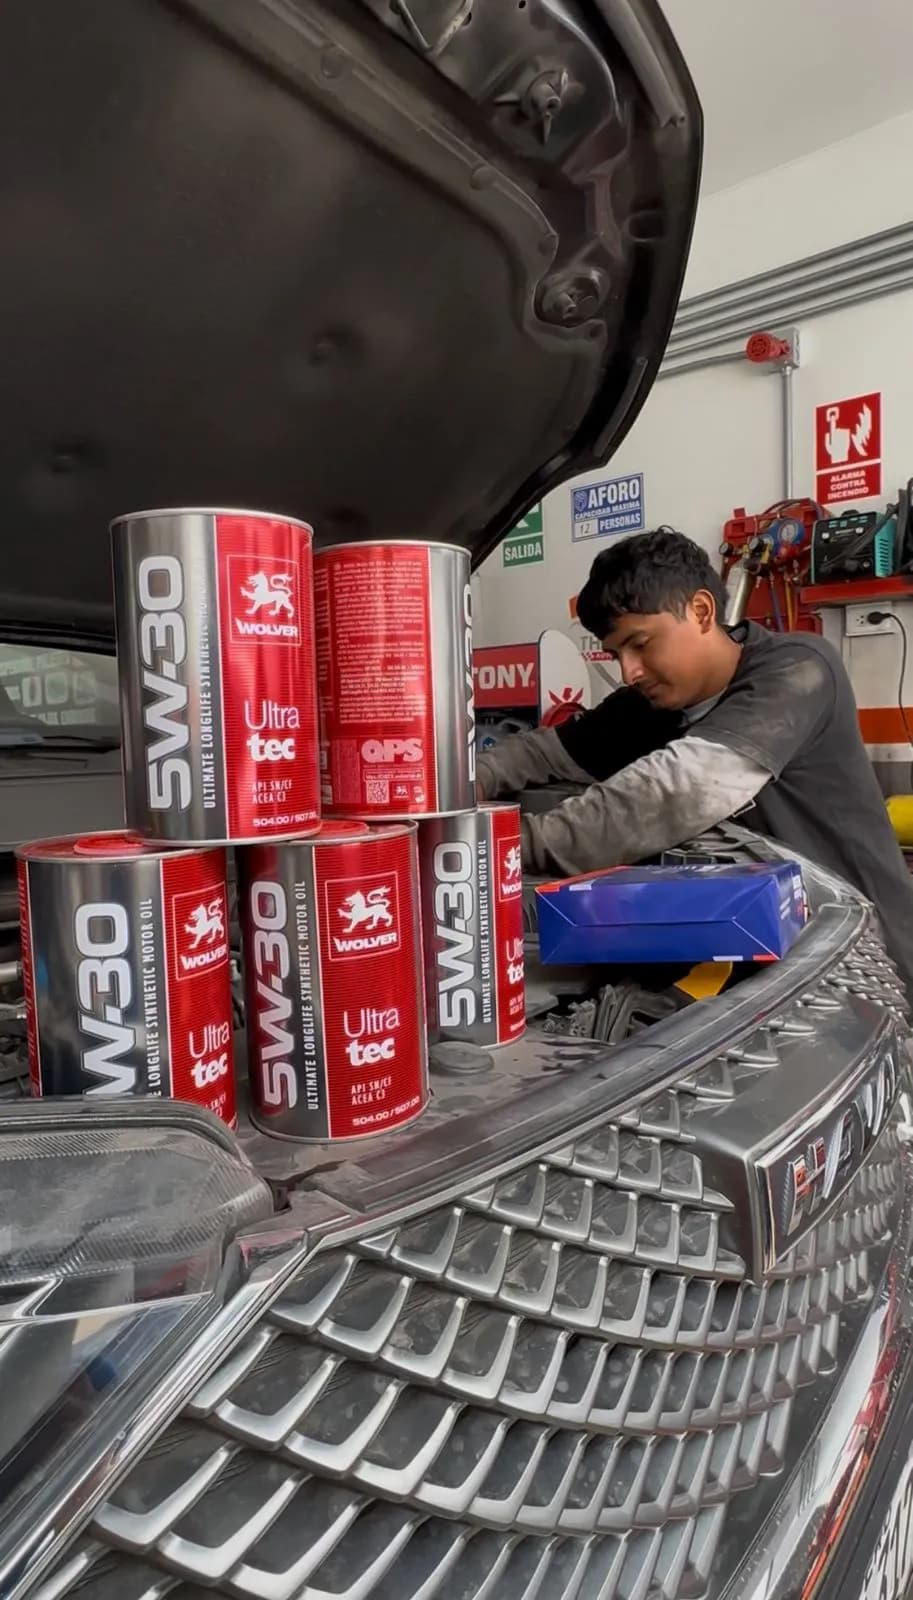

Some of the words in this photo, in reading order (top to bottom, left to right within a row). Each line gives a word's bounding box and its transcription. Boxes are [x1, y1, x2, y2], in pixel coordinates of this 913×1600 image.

[830, 470, 866, 482] ALARMA
[830, 479, 866, 491] CONTRA
[588, 479, 640, 509] AFORO
[827, 487, 869, 500] INCENDIO
[575, 507, 611, 520] CAPACIDAD
[600, 513, 641, 531] PERSONAS
[504, 542, 542, 561] SALIDA
[235, 617, 298, 637] WOLVER
[581, 635, 602, 650] TH
[200, 691, 213, 748] LONGLIFE
[244, 700, 300, 730] Ultra
[246, 732, 296, 762] tec
[203, 753, 216, 809] ULTIMATE
[252, 781, 267, 792] API
[252, 792, 274, 804] ACEA
[252, 815, 290, 827] 504.00
[477, 840, 487, 855] OIL
[478, 858, 488, 887] MOTOR
[295, 881, 306, 899] OIL
[140, 898, 152, 919] OIL
[296, 904, 308, 940] MOTOR
[479, 890, 489, 936] SYNTHETIC
[141, 922, 155, 962] MOTOR
[333, 932, 397, 952] WOLVER
[298, 944, 312, 1000] SYNTHETIC
[480, 938, 490, 980] LONGLIFE
[142, 967, 158, 1029] SYNTHETIC
[482, 983, 492, 1023] ULTIMATE
[302, 1005, 316, 1055] LONGLIFE
[343, 1007, 400, 1038] Ultra
[189, 1021, 230, 1058] Ultra
[345, 1037, 396, 1066] tec
[146, 1032, 161, 1087] LONGLIFE
[191, 1052, 228, 1088] tec
[305, 1060, 319, 1110] ULTIMATE
[351, 1084, 366, 1095] API
[351, 1094, 373, 1106] ACEA
[376, 1089, 386, 1101] C3
[352, 1111, 389, 1127] 504.00
